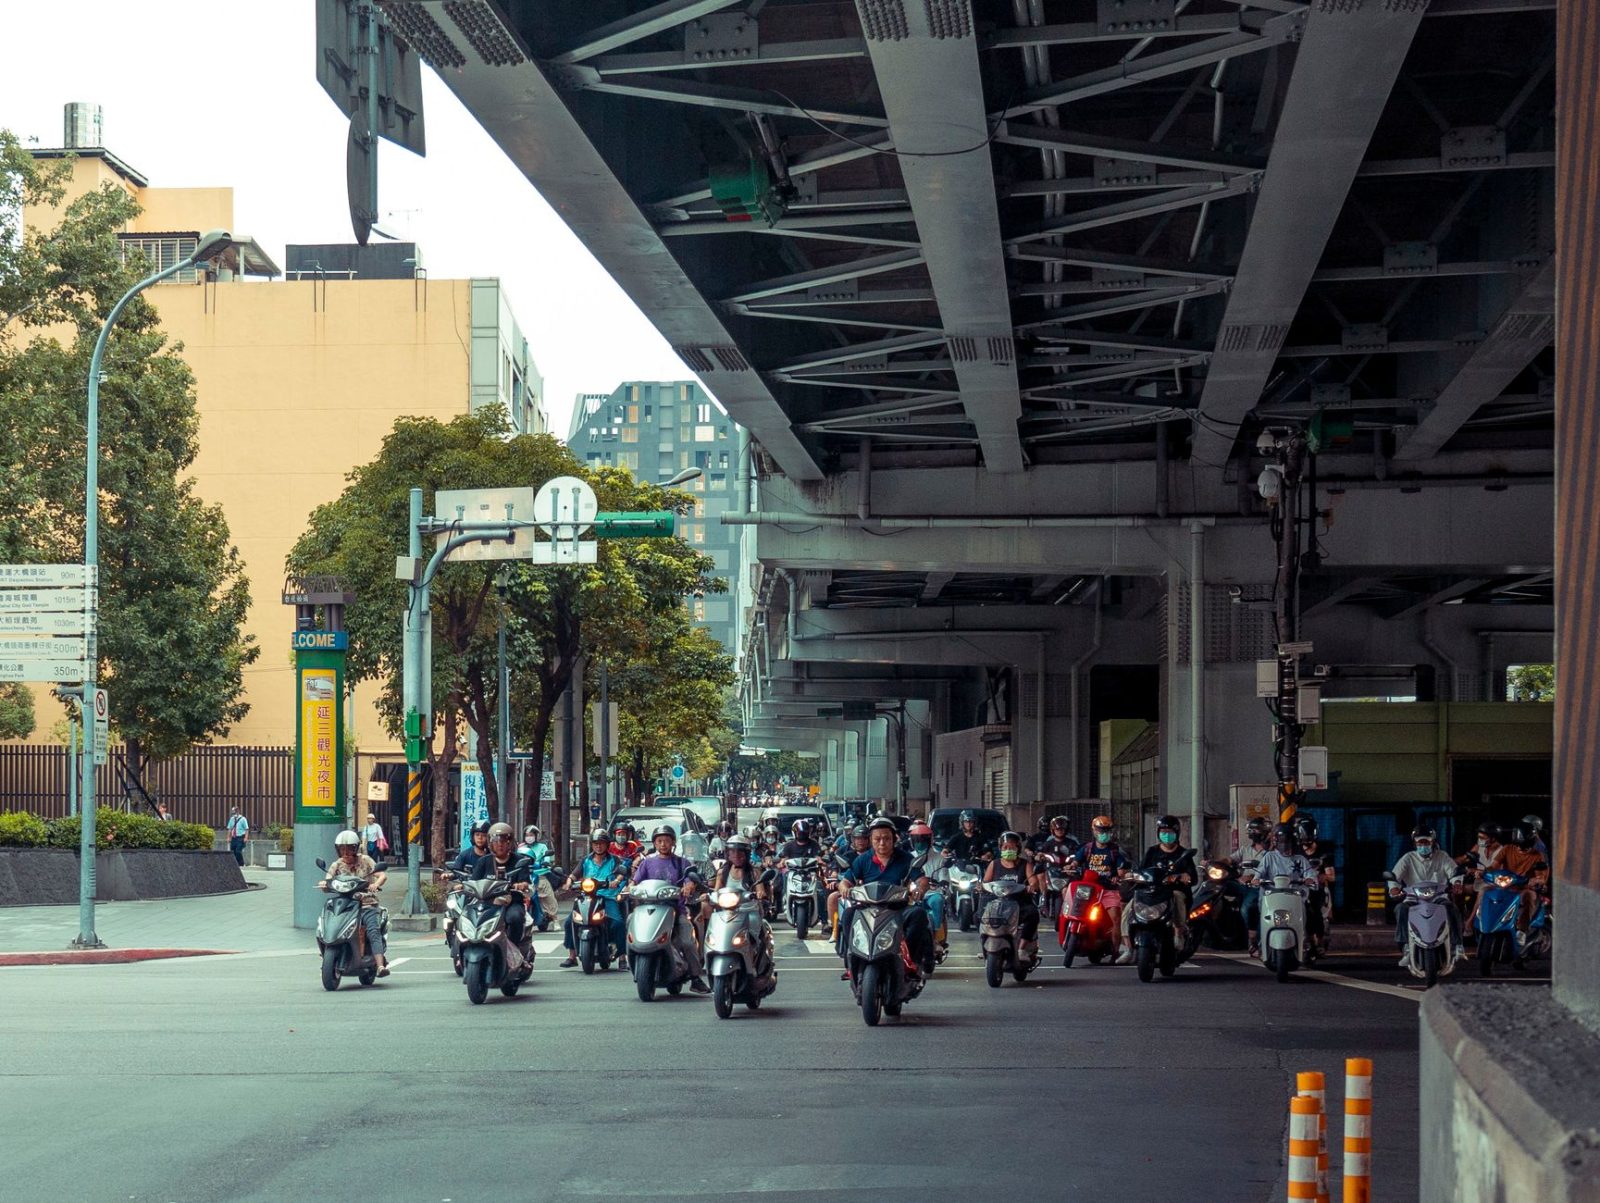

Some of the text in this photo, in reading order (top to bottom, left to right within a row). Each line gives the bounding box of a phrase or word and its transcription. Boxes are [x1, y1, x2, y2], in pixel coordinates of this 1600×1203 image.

[61, 571, 76, 579] 90m
[55, 596, 76, 604] 1015m
[291, 633, 336, 648] LCOME
[53, 644, 78, 654] 500m
[54, 666, 78, 676] 350m
[317, 705, 331, 800] 延三觀光夜市
